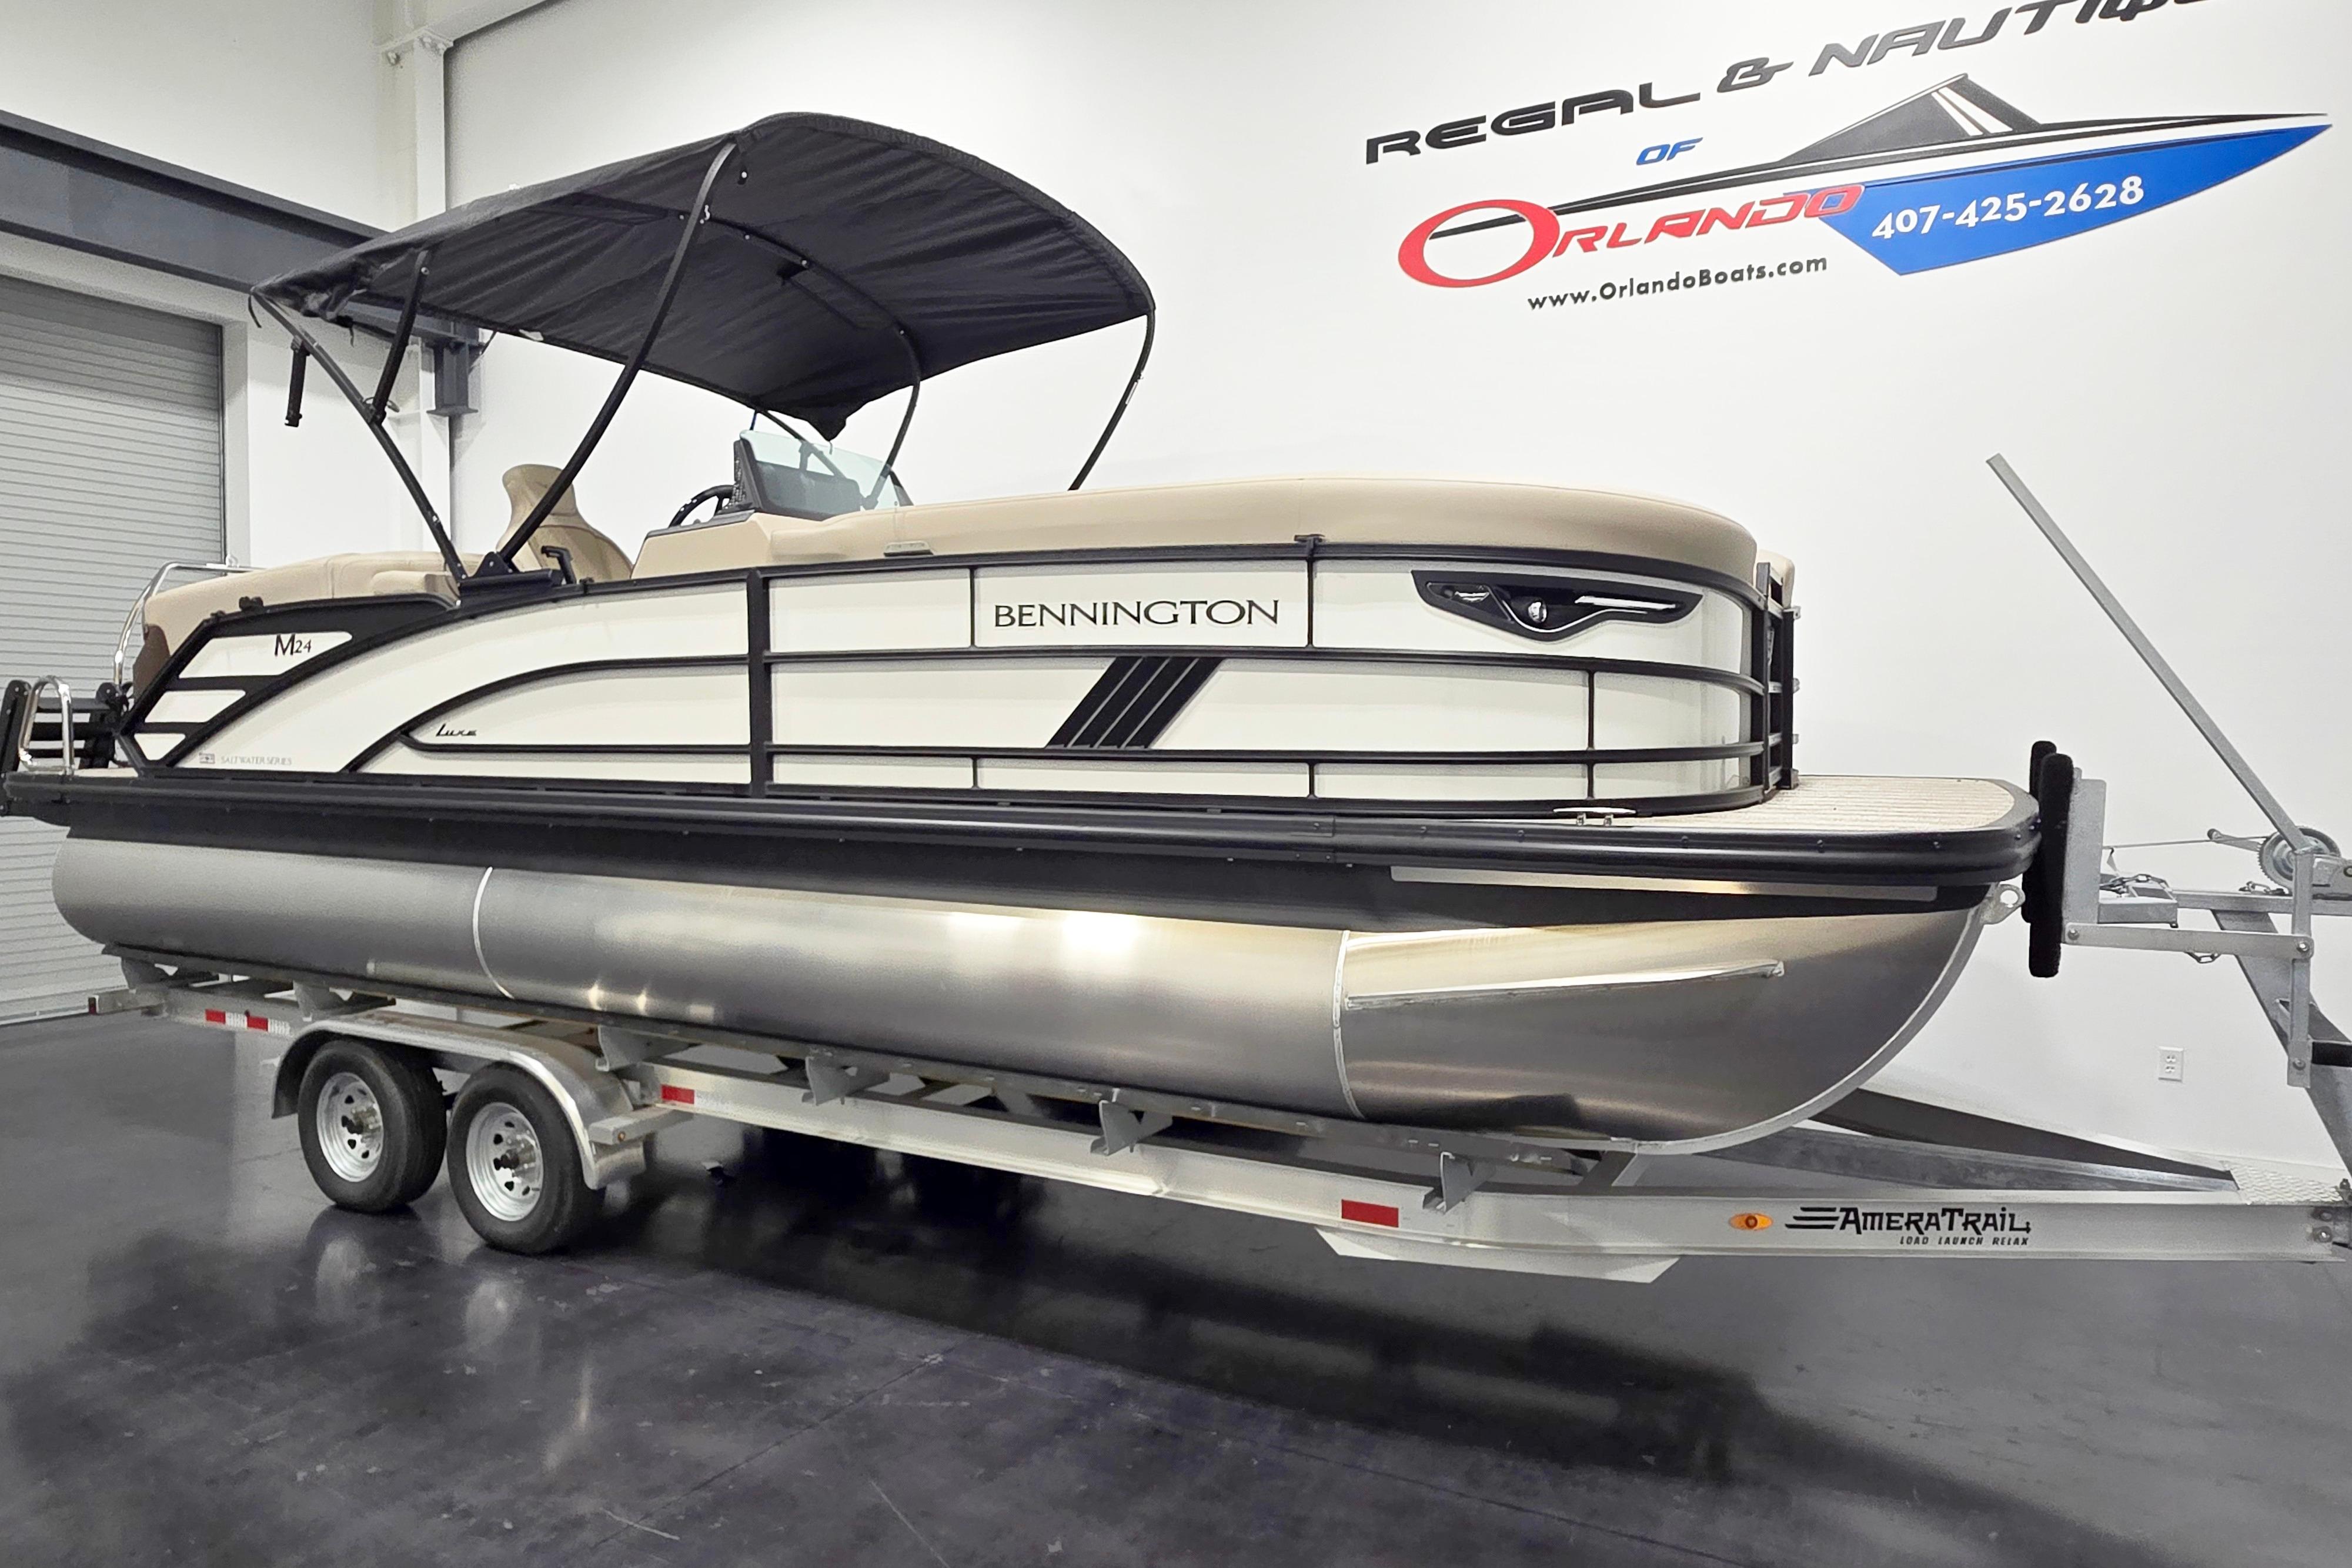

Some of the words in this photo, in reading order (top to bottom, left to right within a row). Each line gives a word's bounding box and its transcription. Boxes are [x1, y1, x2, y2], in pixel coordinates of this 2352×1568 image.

[1366, 82, 1701, 165] REGAL
[1717, 57, 1795, 93] &
[1636, 137, 1704, 166] OF
[1872, 176, 2144, 239] 407-425-2628
[1528, 255, 1828, 310] www.OrlandoBoats.com
[994, 600, 1279, 627] BENNINGTON
[275, 634, 312, 656] M24
[1900, 1236, 1929, 1245] LOAD
[1937, 1236, 1984, 1245] LAUNCH
[1992, 1237, 2029, 1245] RELAX
